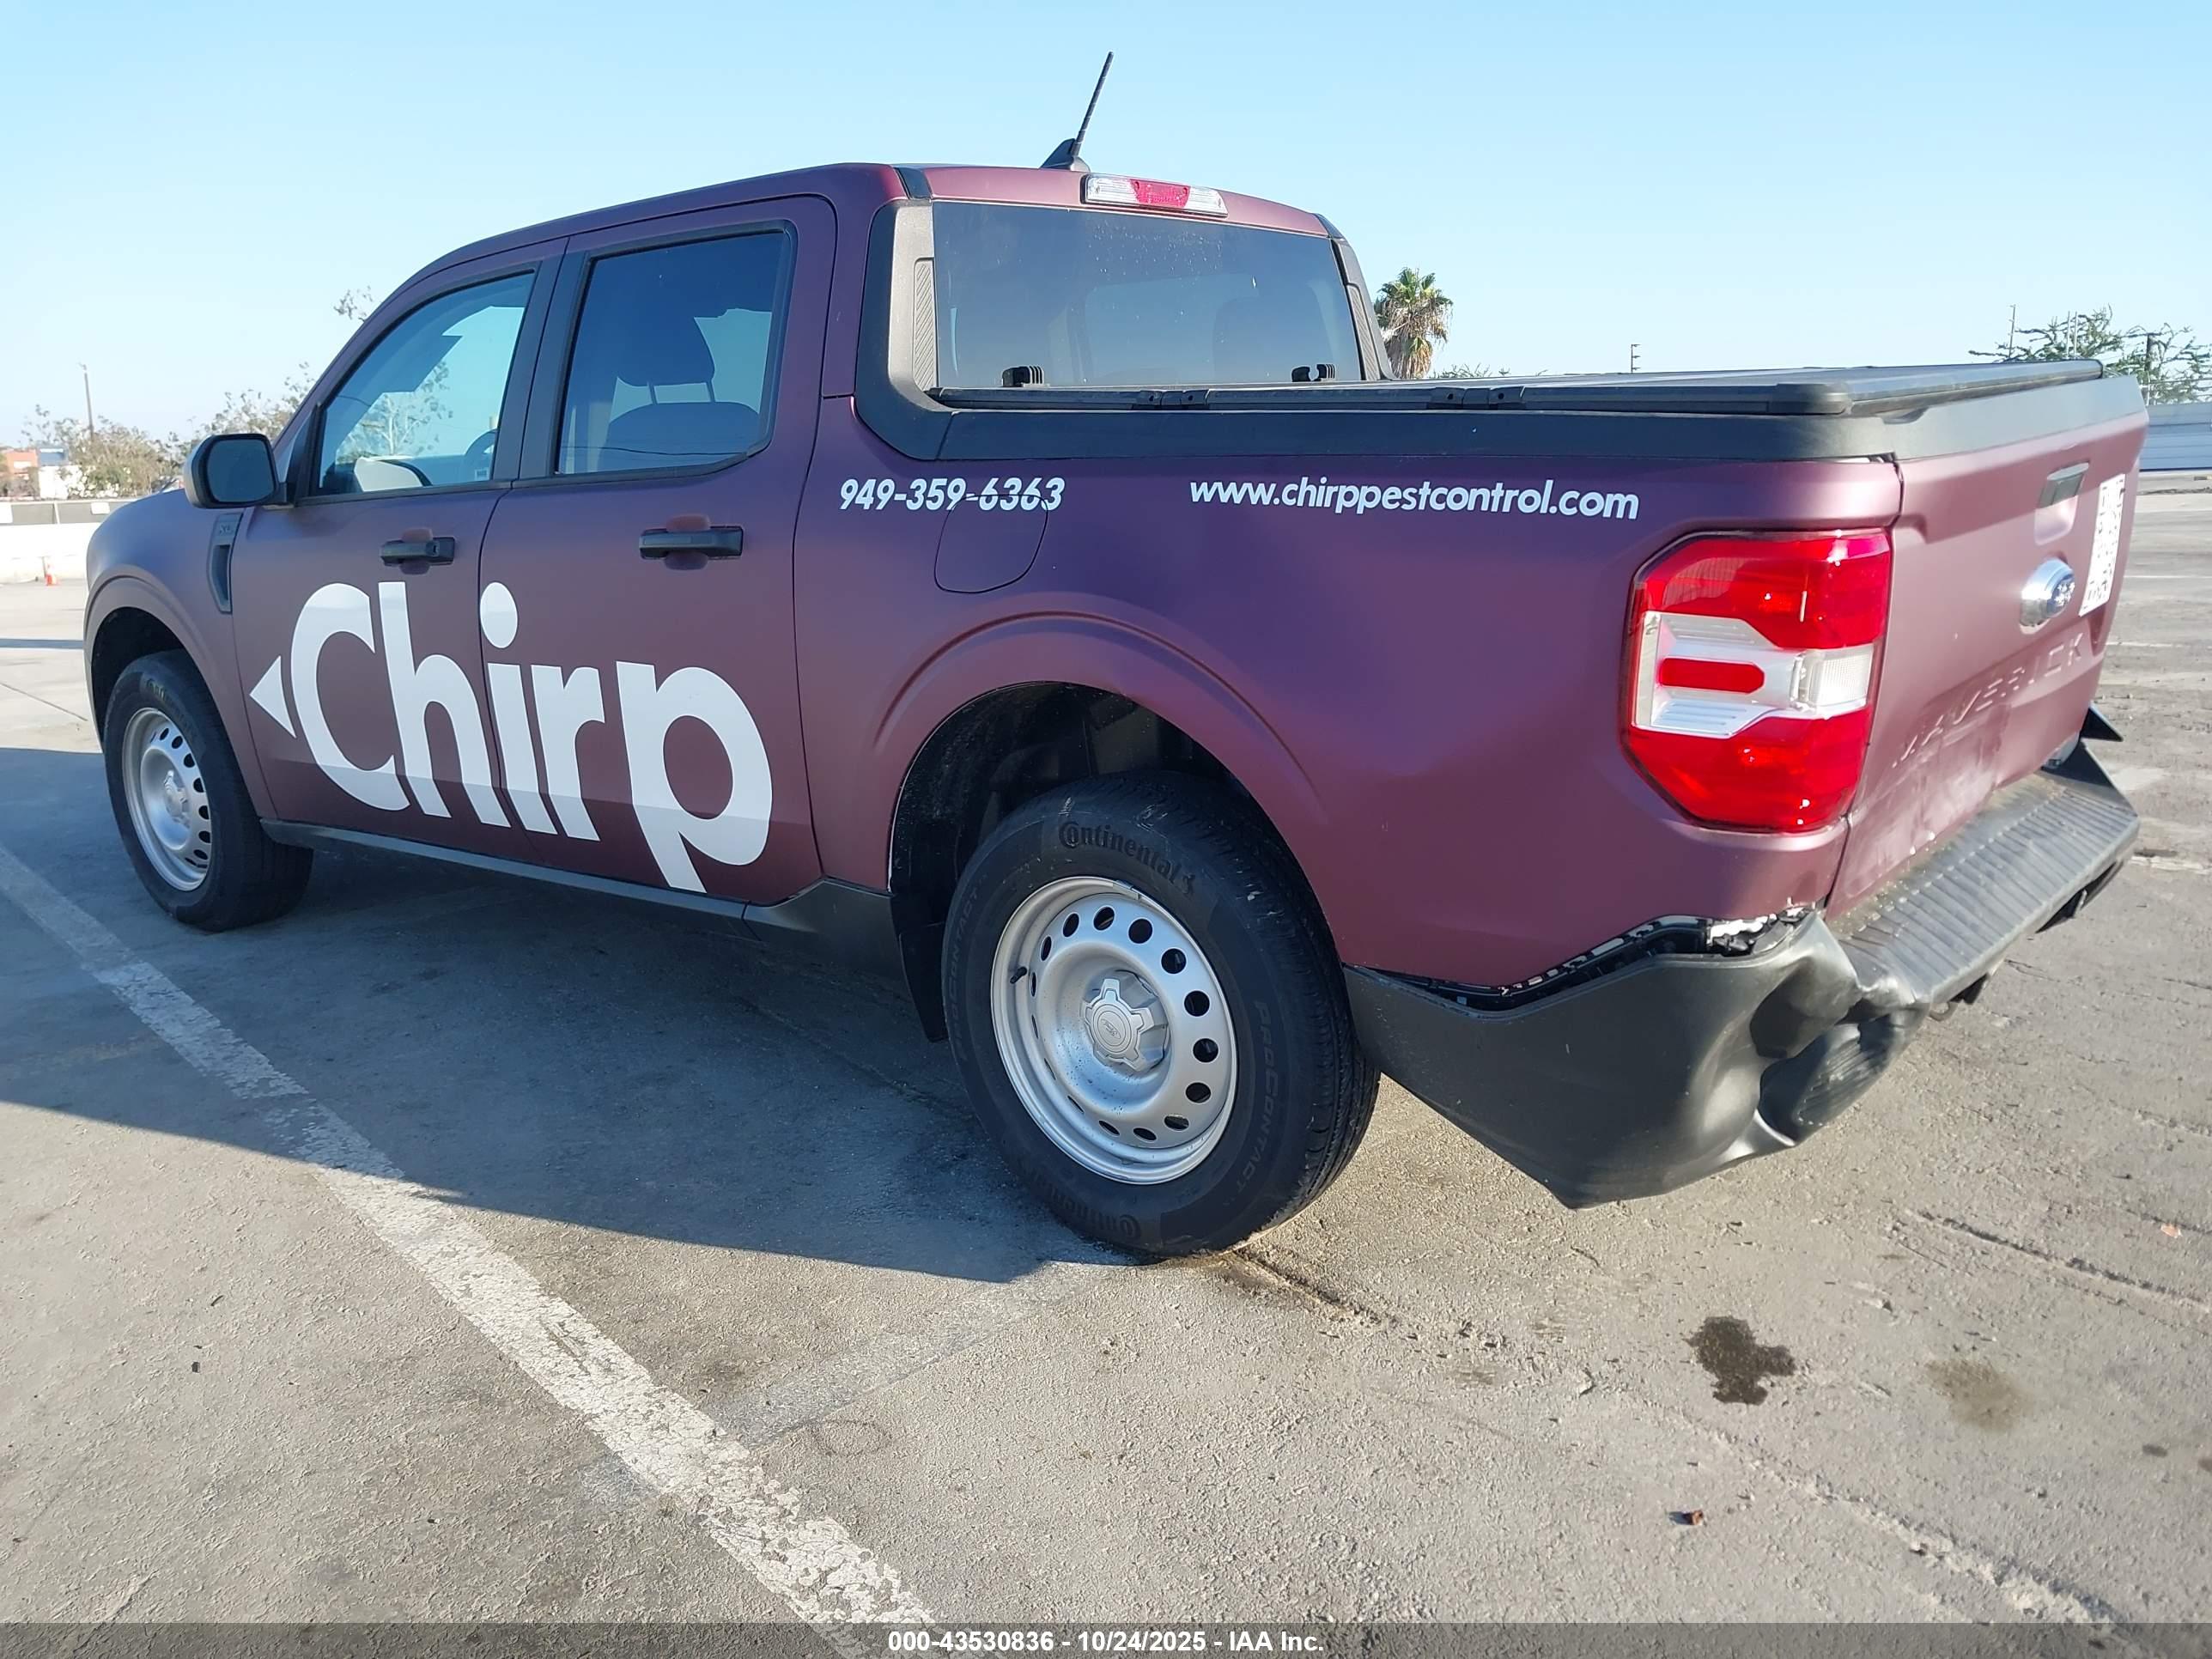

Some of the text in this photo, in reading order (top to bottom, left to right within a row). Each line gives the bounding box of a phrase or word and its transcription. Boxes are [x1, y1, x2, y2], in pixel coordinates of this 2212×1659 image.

[840, 477, 1066, 511] 949-359-6363
[1190, 477, 1640, 520] www.chirppestcontrol.com
[290, 581, 773, 894] Chirp
[1058, 821, 1182, 885] Continental
